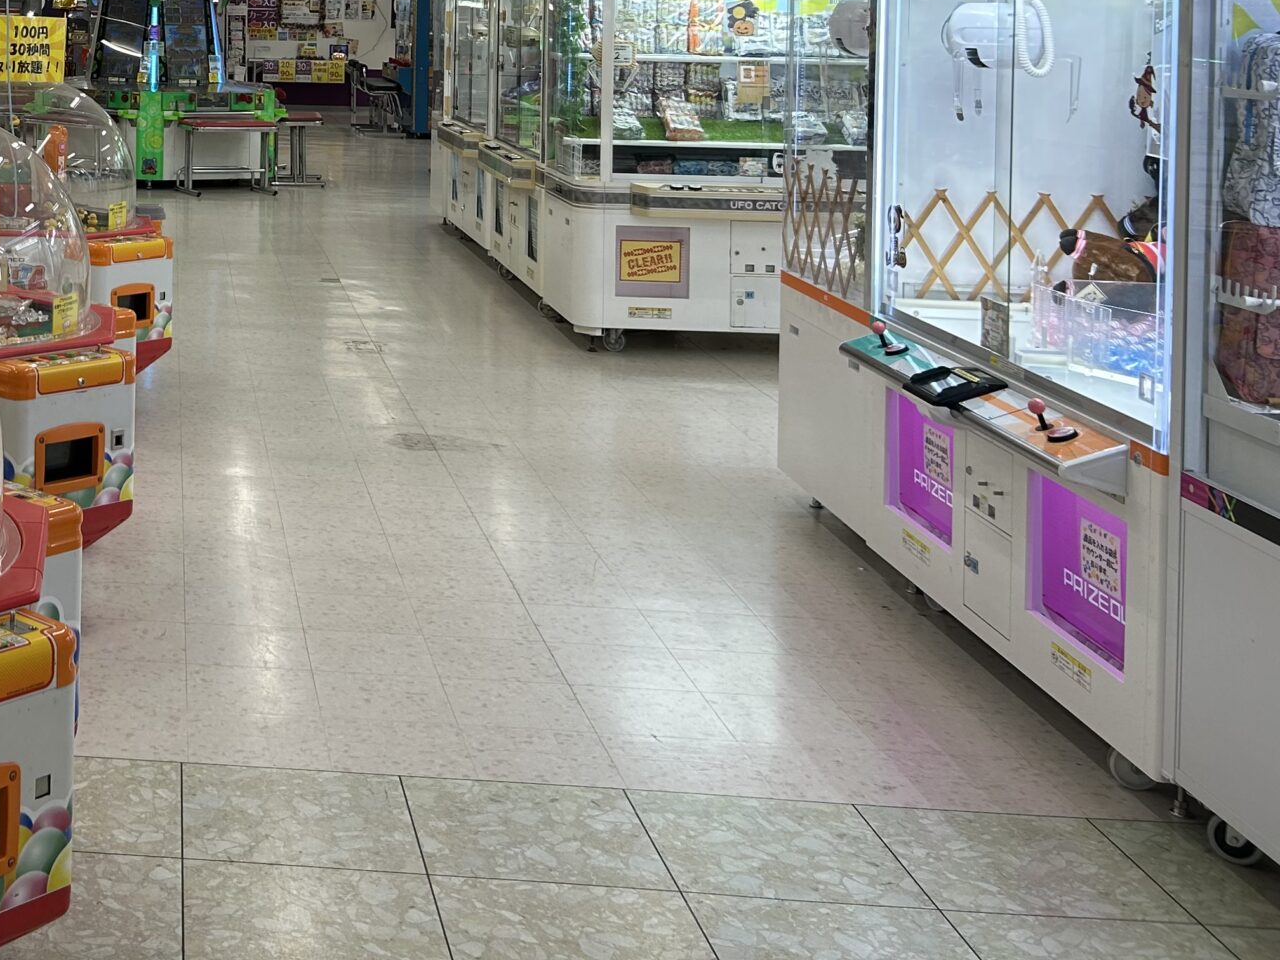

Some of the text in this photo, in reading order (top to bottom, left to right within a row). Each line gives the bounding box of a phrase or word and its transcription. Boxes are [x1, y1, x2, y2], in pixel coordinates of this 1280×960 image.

[262, 0, 277, 7] 入口
[13, 25, 49, 39] 100円
[9, 43, 50, 57] 30秒間
[730, 201, 753, 209] UFO
[627, 253, 674, 271] CLEAR!!
